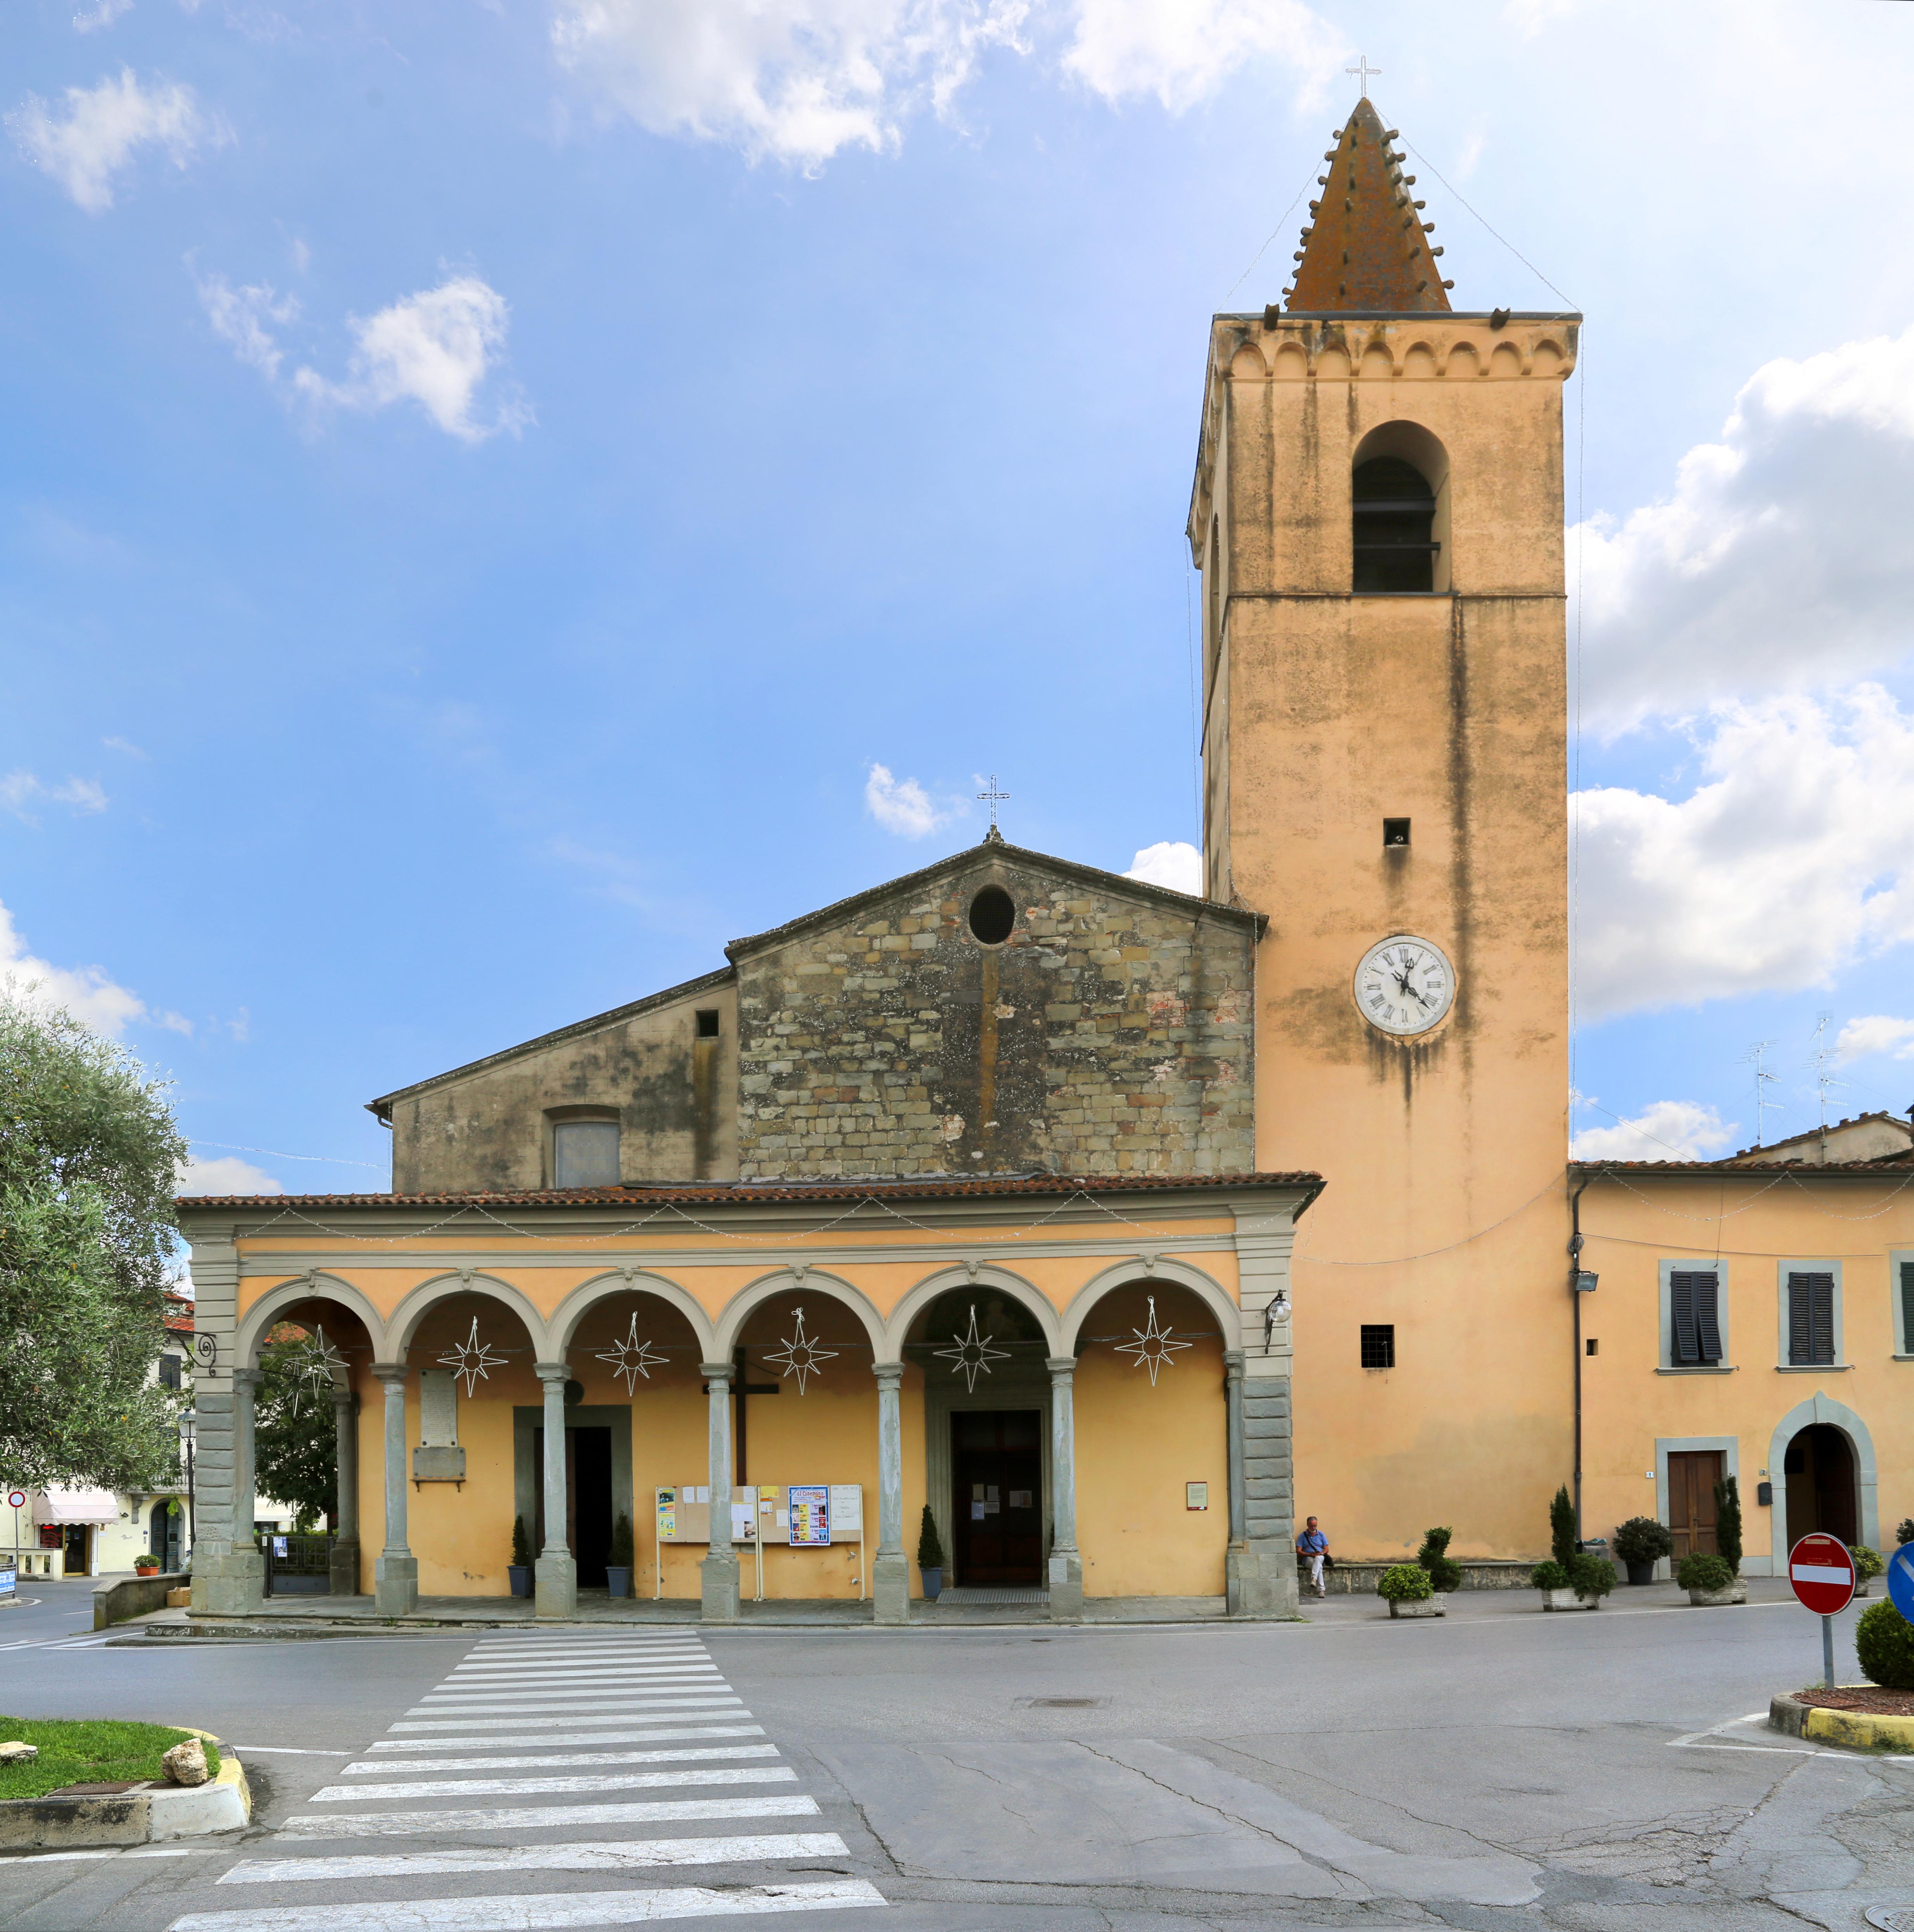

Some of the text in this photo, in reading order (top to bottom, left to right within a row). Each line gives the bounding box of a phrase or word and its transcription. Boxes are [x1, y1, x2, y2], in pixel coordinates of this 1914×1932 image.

[1382, 953, 1395, 967] XI
[1399, 949, 1408, 963] XII
[1423, 965, 1437, 975] II
